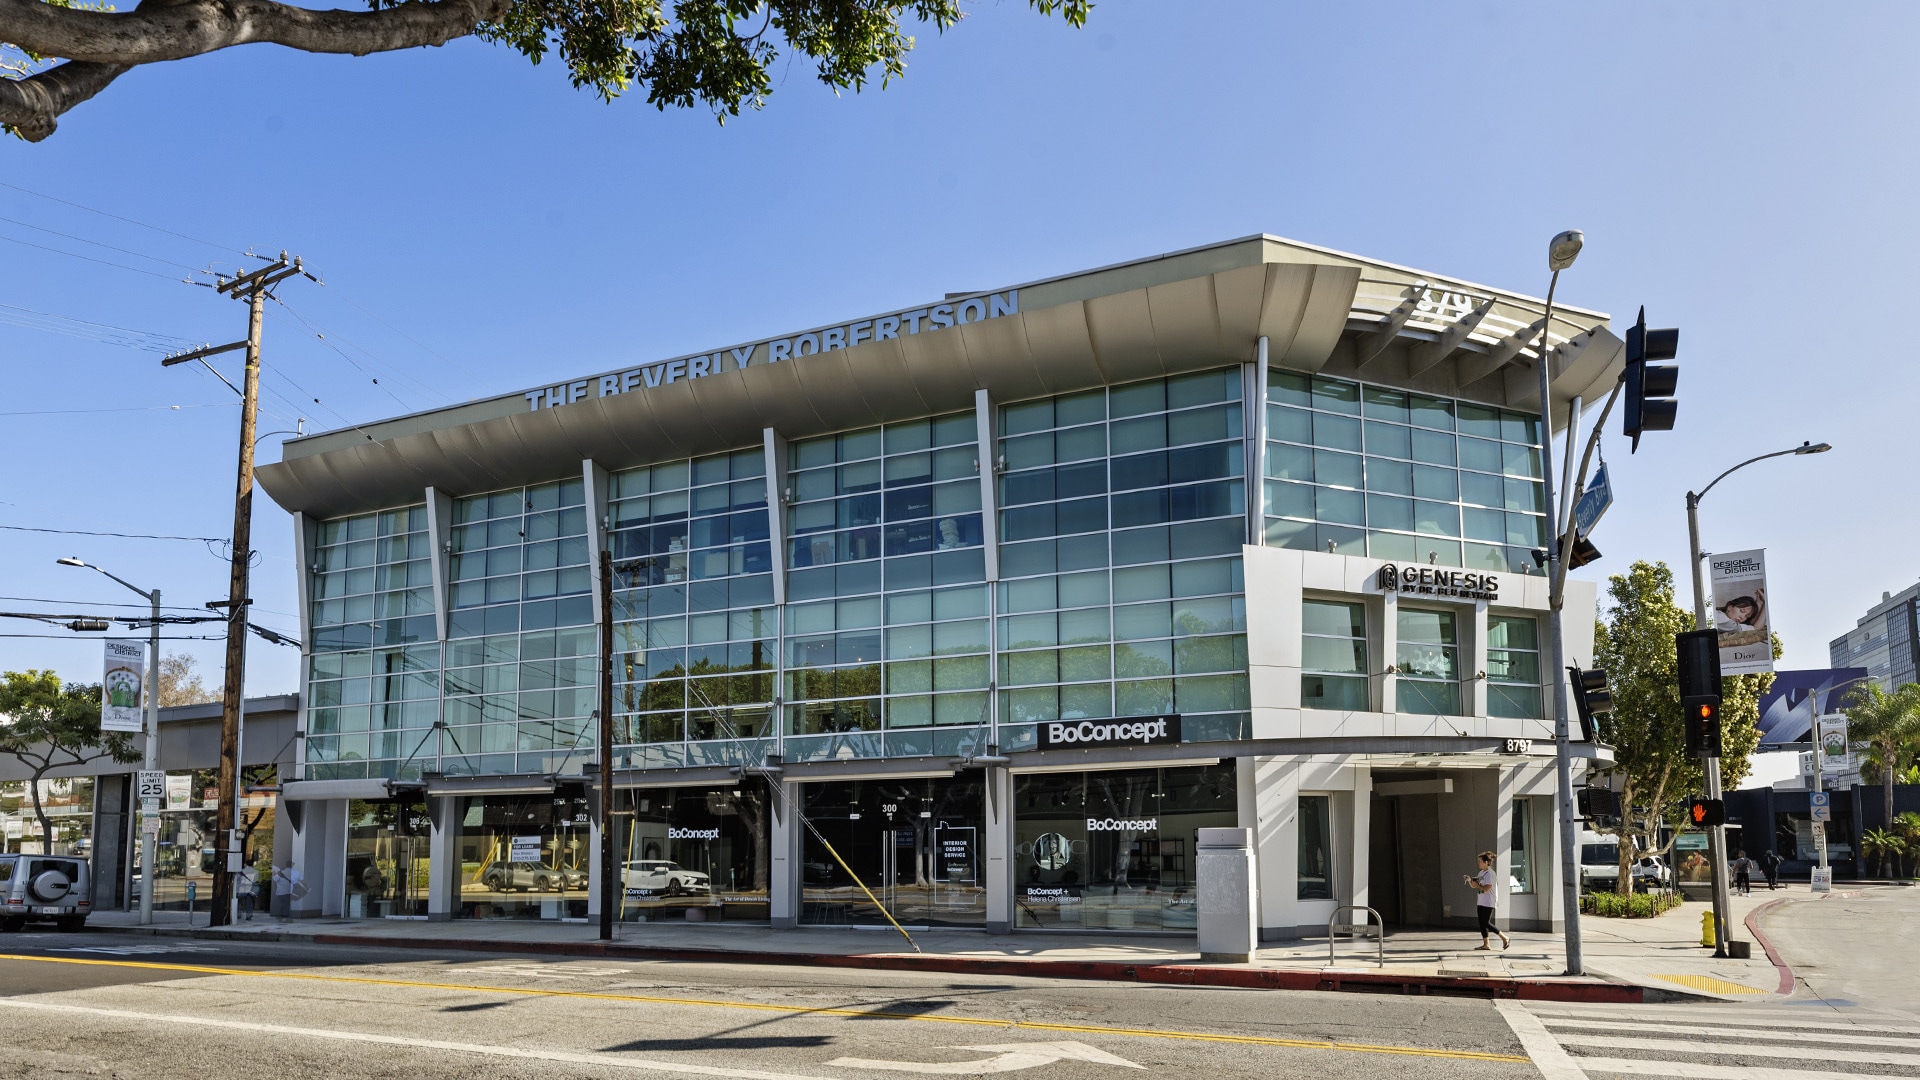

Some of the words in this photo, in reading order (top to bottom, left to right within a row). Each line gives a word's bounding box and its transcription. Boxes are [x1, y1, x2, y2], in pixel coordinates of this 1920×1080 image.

[525, 380, 588, 411] THE
[769, 290, 1019, 363] ROBERTSON
[1725, 563, 1761, 574] DISTRICT
[1403, 567, 1499, 591] GENESIS
[1402, 584, 1416, 592] BY
[1438, 588, 1457, 596] BEN
[1734, 652, 1755, 660] Dior
[1049, 718, 1167, 743] BoConcept
[1507, 739, 1532, 752] 8797
[141, 784, 163, 795] 25
[882, 804, 898, 813] 300
[576, 813, 588, 822] 302
[1086, 817, 1158, 833] BoConcept
[668, 827, 720, 841] BoConcept
[1027, 888, 1063, 897] BoConcept
